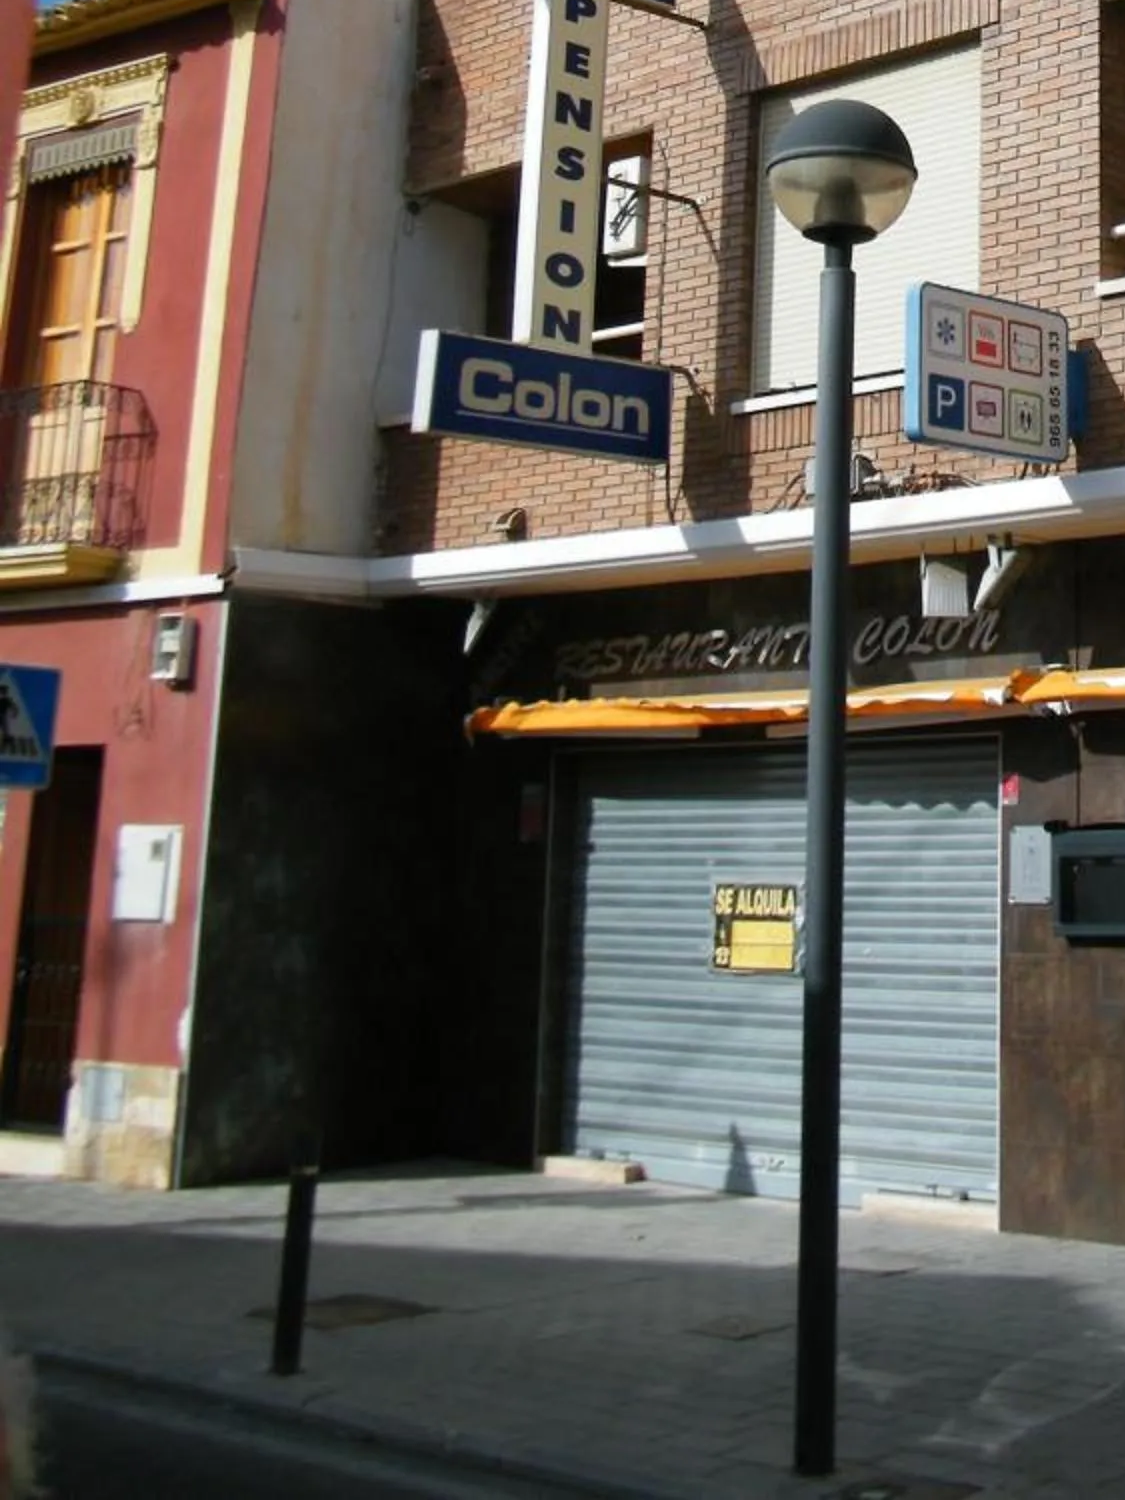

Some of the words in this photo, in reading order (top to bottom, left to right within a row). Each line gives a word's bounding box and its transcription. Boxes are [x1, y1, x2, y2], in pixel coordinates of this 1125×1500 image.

[458, 357, 651, 436] Colon
[936, 384, 957, 419] P
[555, 622, 812, 679] RESTAURANT
[715, 887, 734, 915] SE
[735, 887, 795, 916] ALQUILA
